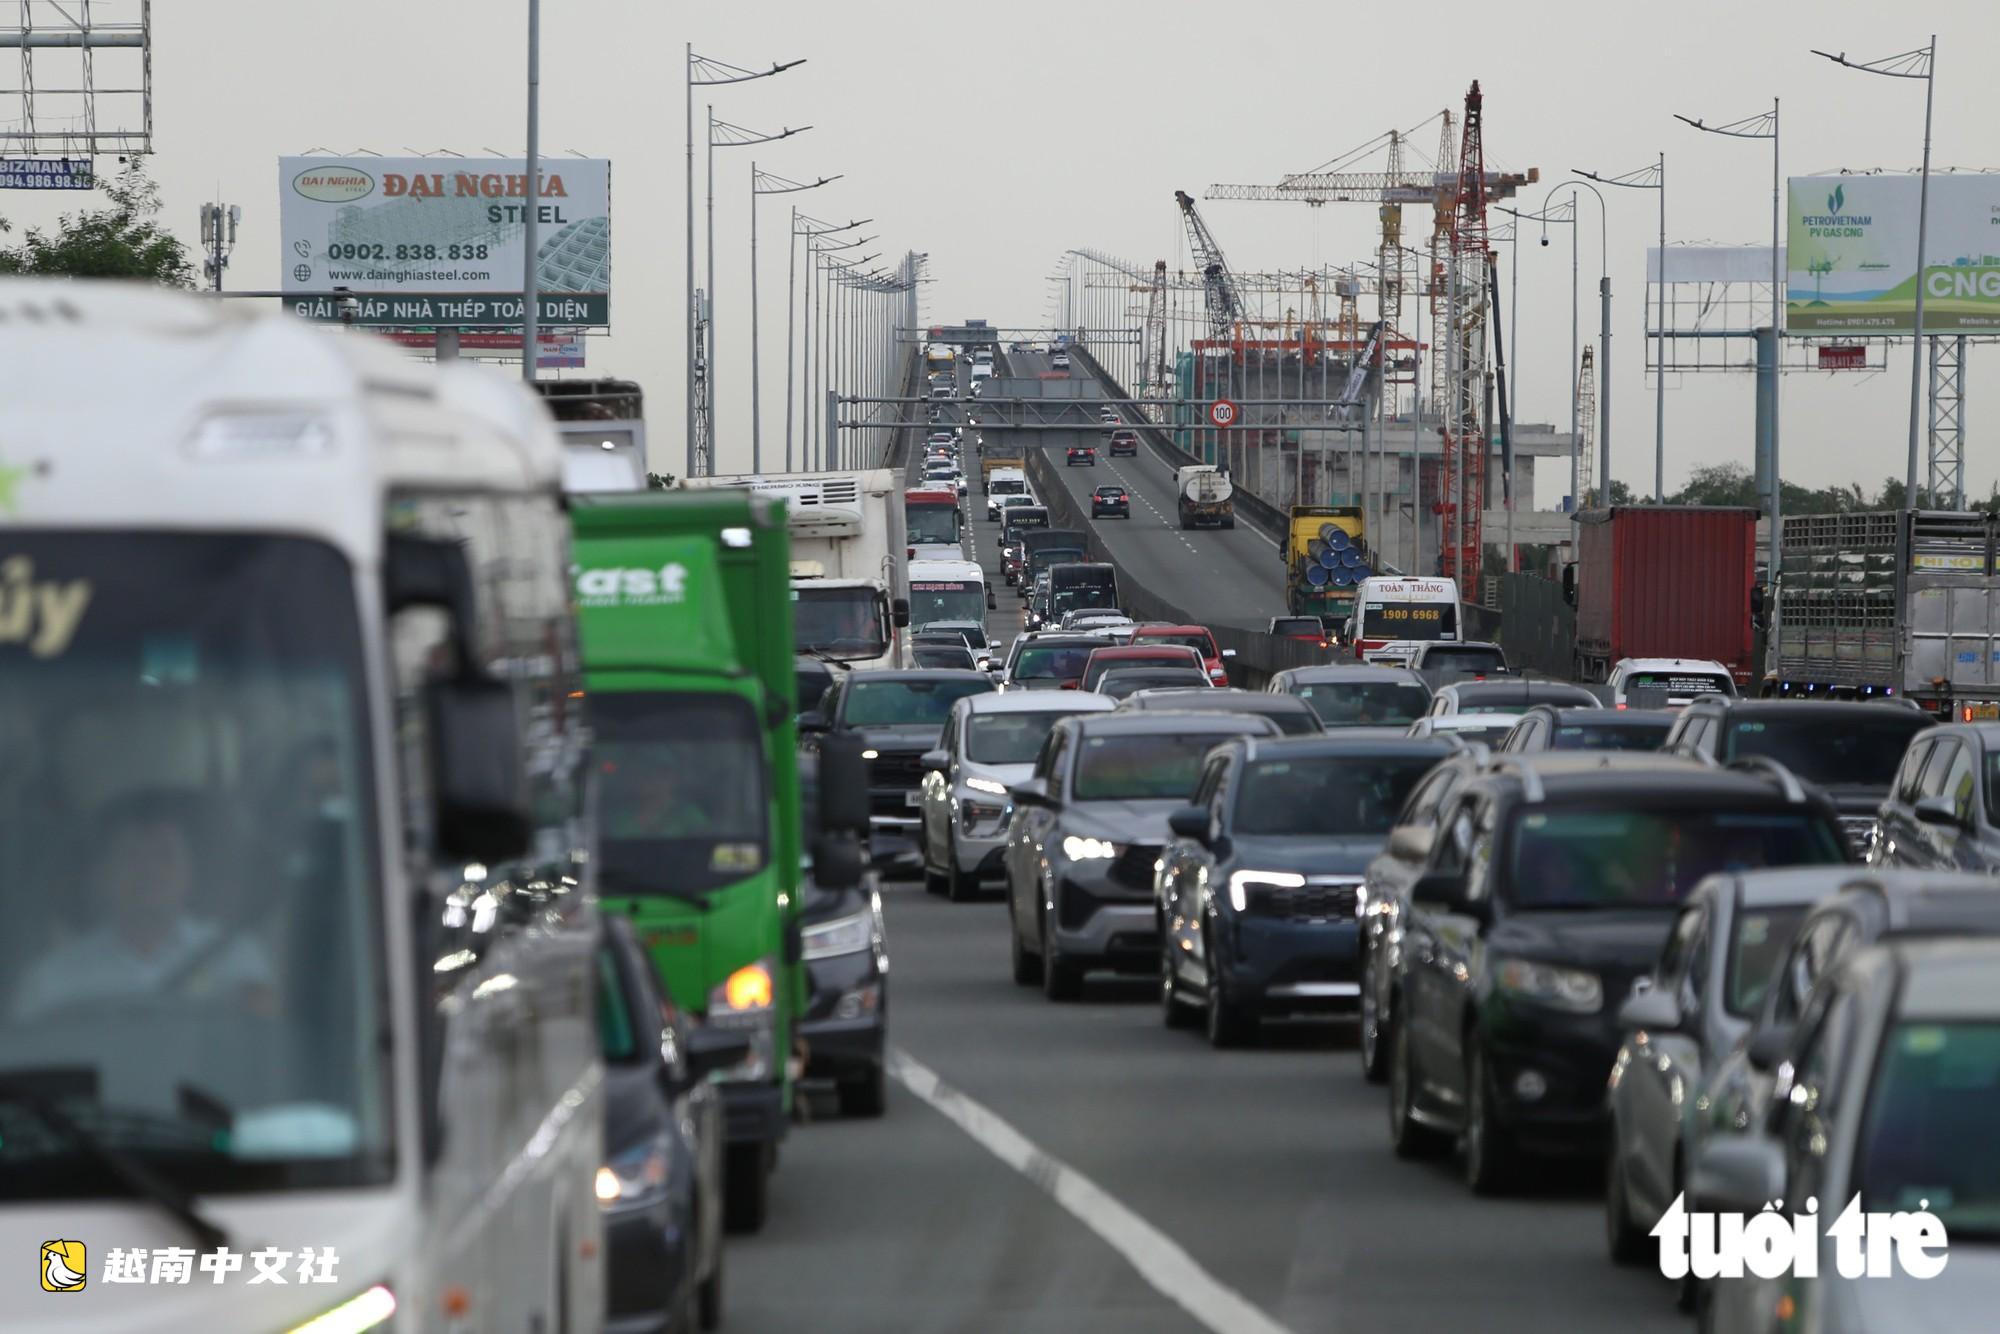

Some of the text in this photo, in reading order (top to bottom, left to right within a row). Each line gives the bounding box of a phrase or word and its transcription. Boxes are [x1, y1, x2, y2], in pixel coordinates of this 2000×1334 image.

[0, 161, 91, 174] BIZMAN.VN
[382, 172, 446, 202] ĐẠI
[1803, 215, 1872, 226] PETROVIETNAM
[1810, 227, 1863, 238] PV GAS CNG
[328, 268, 491, 283] www.dainghiasteel.com
[1927, 271, 2000, 298] CNG
[295, 297, 332, 318] GIẢI
[337, 298, 389, 318] HÁP
[393, 298, 433, 318] NHÀ
[437, 299, 486, 318] THÉP
[546, 299, 588, 321] DIỆN
[1215, 407, 1231, 419] 100
[568, 562, 690, 595] ast
[1379, 582, 1404, 593] TOÀN
[1382, 610, 1440, 620] 1900 6968
